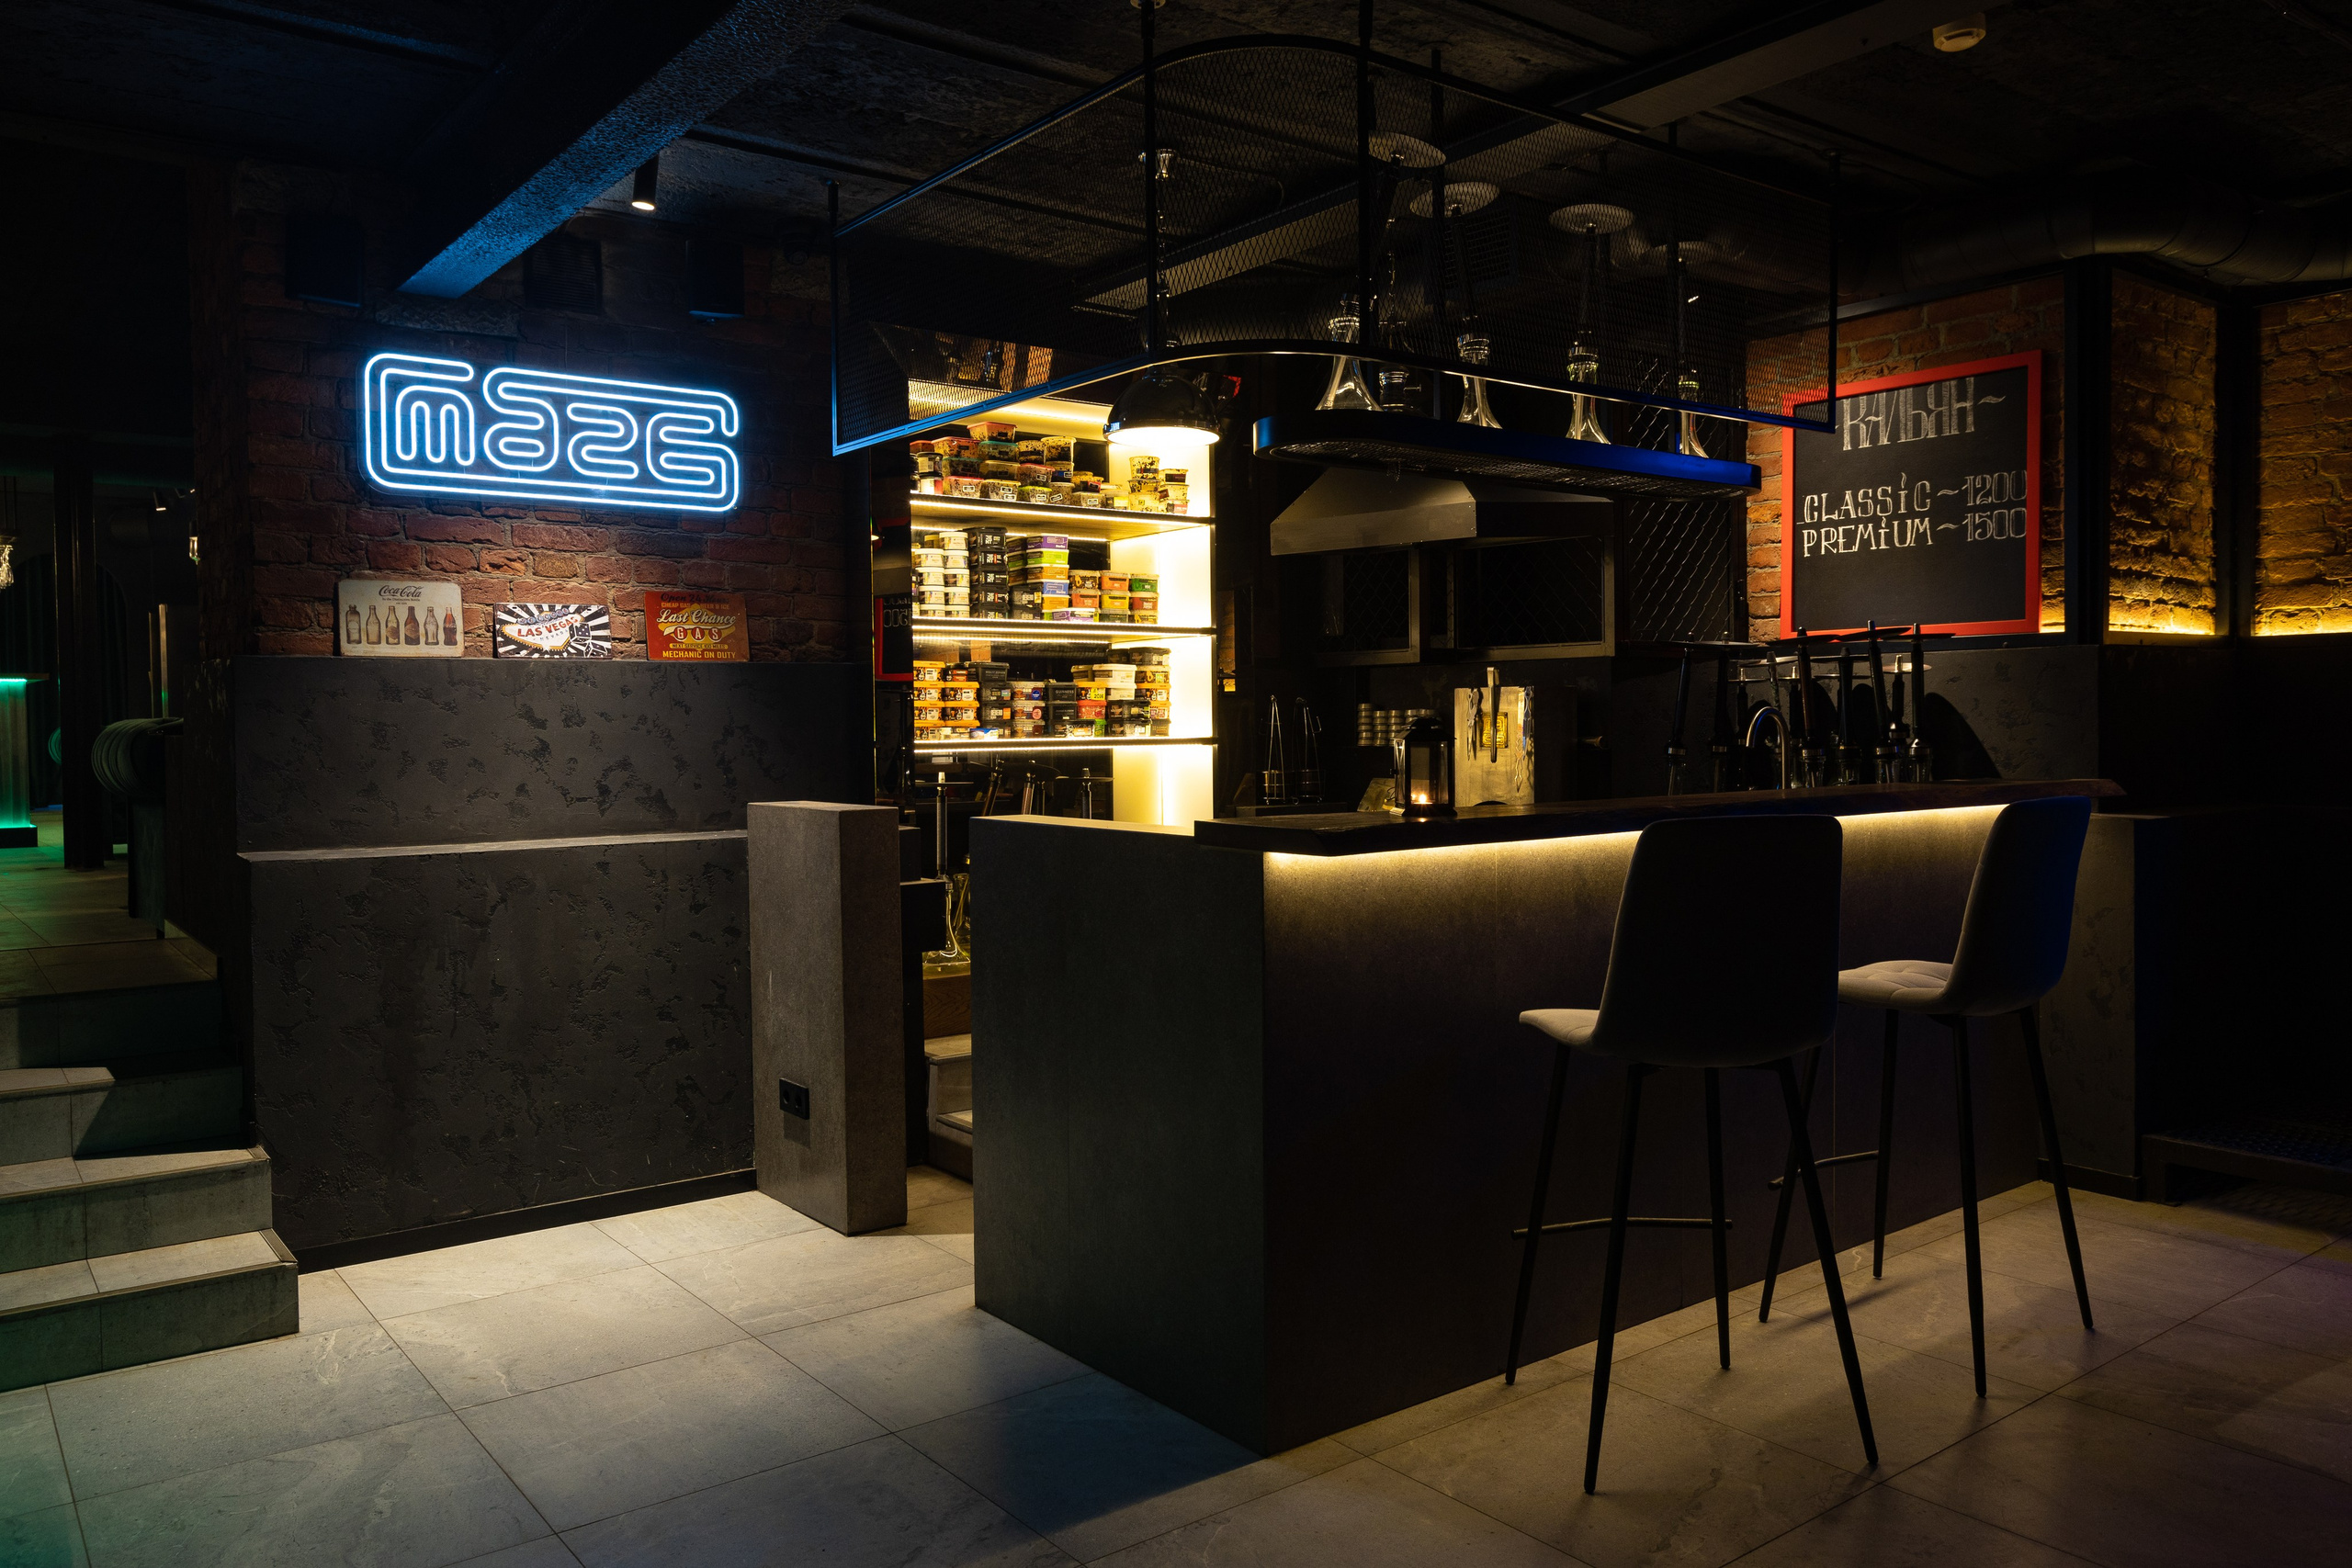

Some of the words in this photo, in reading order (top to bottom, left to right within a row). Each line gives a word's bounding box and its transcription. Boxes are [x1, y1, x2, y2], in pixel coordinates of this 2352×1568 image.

[379, 584, 424, 598] Coca-Cola
[661, 592, 686, 603] Open
[656, 608, 689, 623] Last
[690, 609, 736, 624] Chance
[517, 627, 542, 637] LAS
[545, 616, 578, 633] VEGAS
